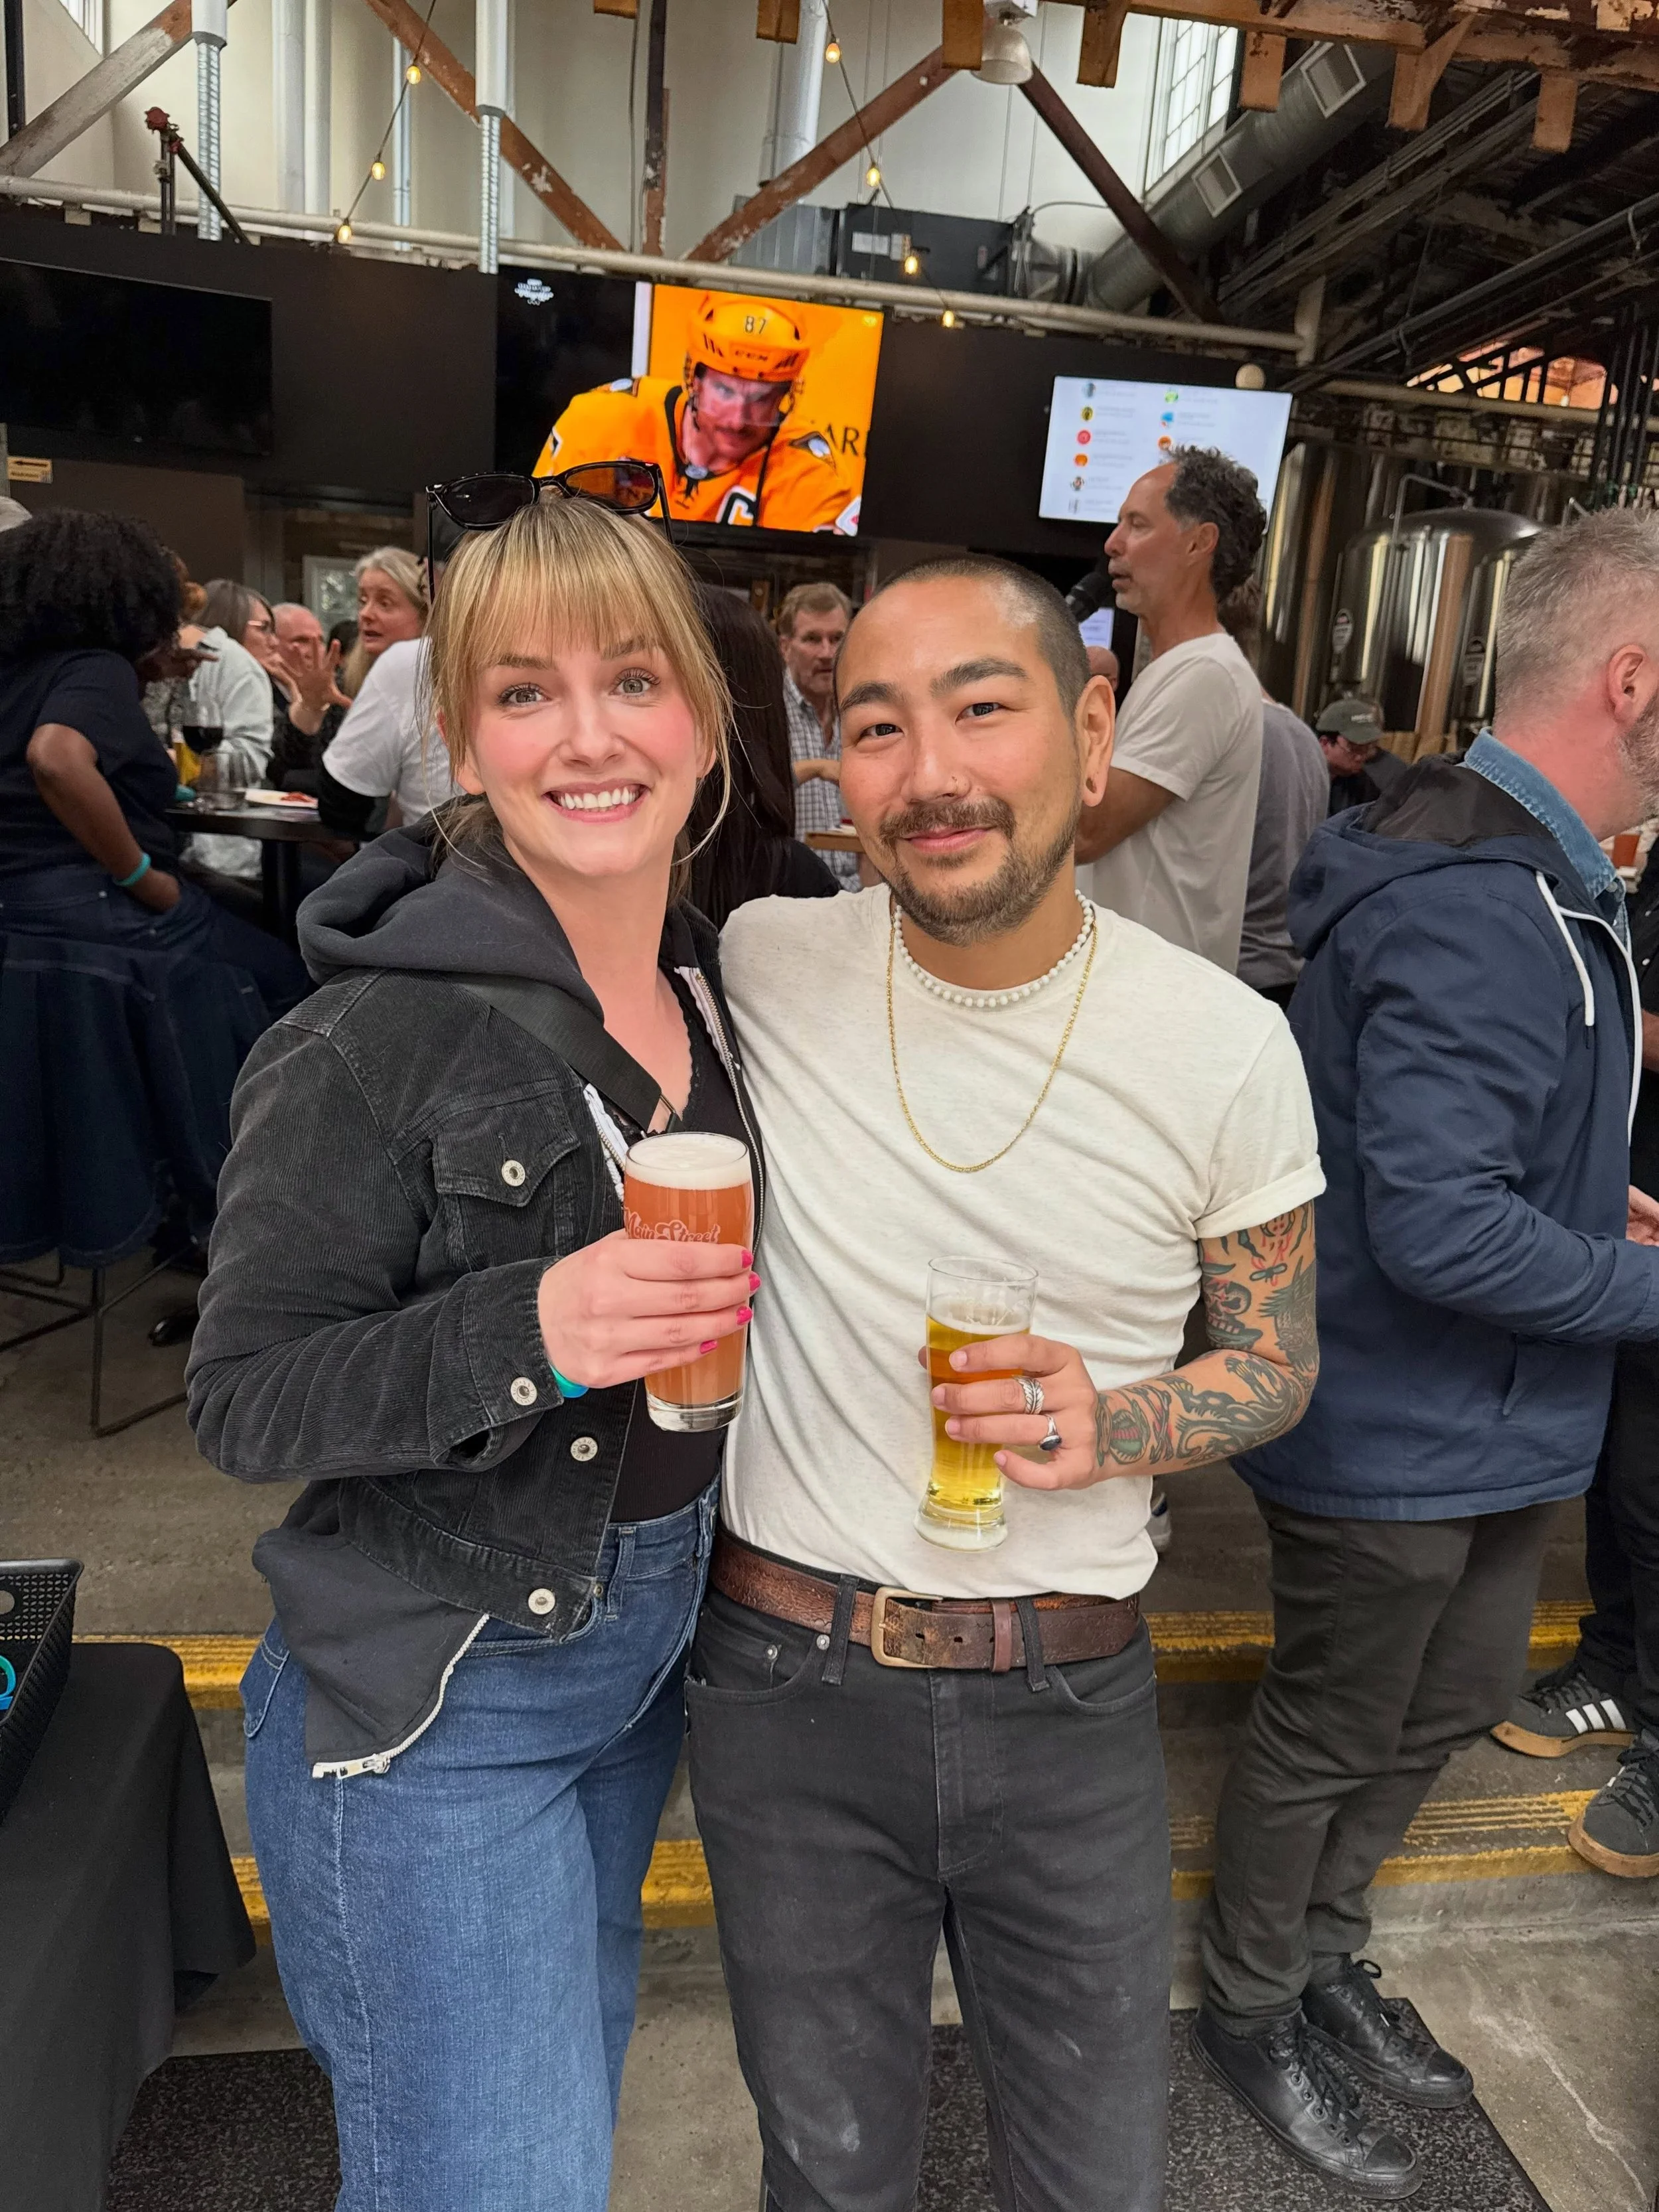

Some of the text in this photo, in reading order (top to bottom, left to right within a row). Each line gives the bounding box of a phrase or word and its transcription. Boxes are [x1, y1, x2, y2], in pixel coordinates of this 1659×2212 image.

[745, 315, 766, 334] 87
[624, 1207, 721, 1243] Main Street
